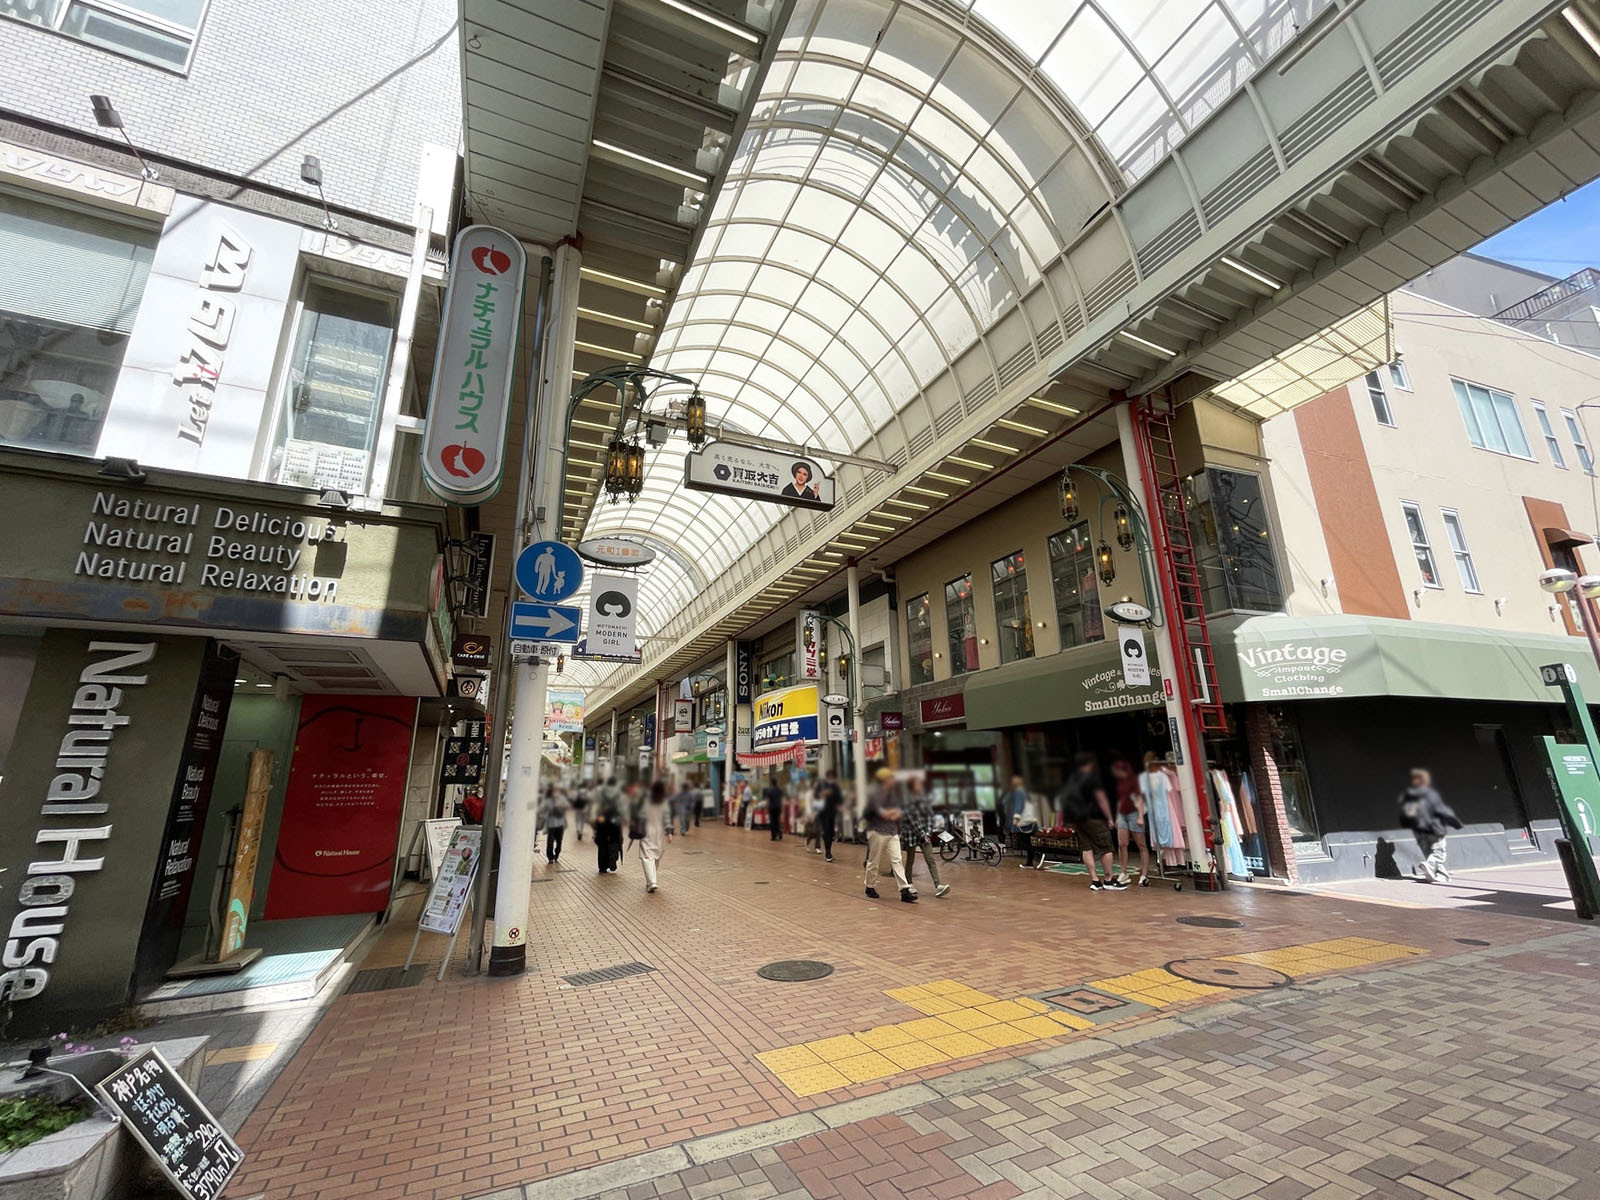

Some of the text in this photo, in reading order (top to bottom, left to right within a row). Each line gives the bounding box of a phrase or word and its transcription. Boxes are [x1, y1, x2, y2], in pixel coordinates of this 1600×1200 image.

[454, 281, 500, 434] ナチュラルハウス
[732, 466, 780, 485] 買取大吉
[92, 491, 199, 526] Natural
[84, 521, 300, 571] Natural Beauty
[74, 551, 338, 597] Natural Relaxation
[595, 630, 628, 638] MODERN
[602, 638, 621, 646] GIRL
[1237, 643, 1347, 668] Vintage
[738, 649, 748, 697] SONY
[1081, 668, 1117, 690] Vintage
[1274, 674, 1325, 683] Clothing
[1084, 690, 1166, 712] SmallChange
[1262, 685, 1344, 697] SmallChange
[759, 701, 784, 719] Nikon
[0, 639, 157, 1003] Natural House
[168, 838, 190, 857] Natural
[111, 1058, 164, 1103] 神戸名物
[133, 1082, 167, 1114] ぼっかけ
[146, 1097, 177, 1124] そばめし
